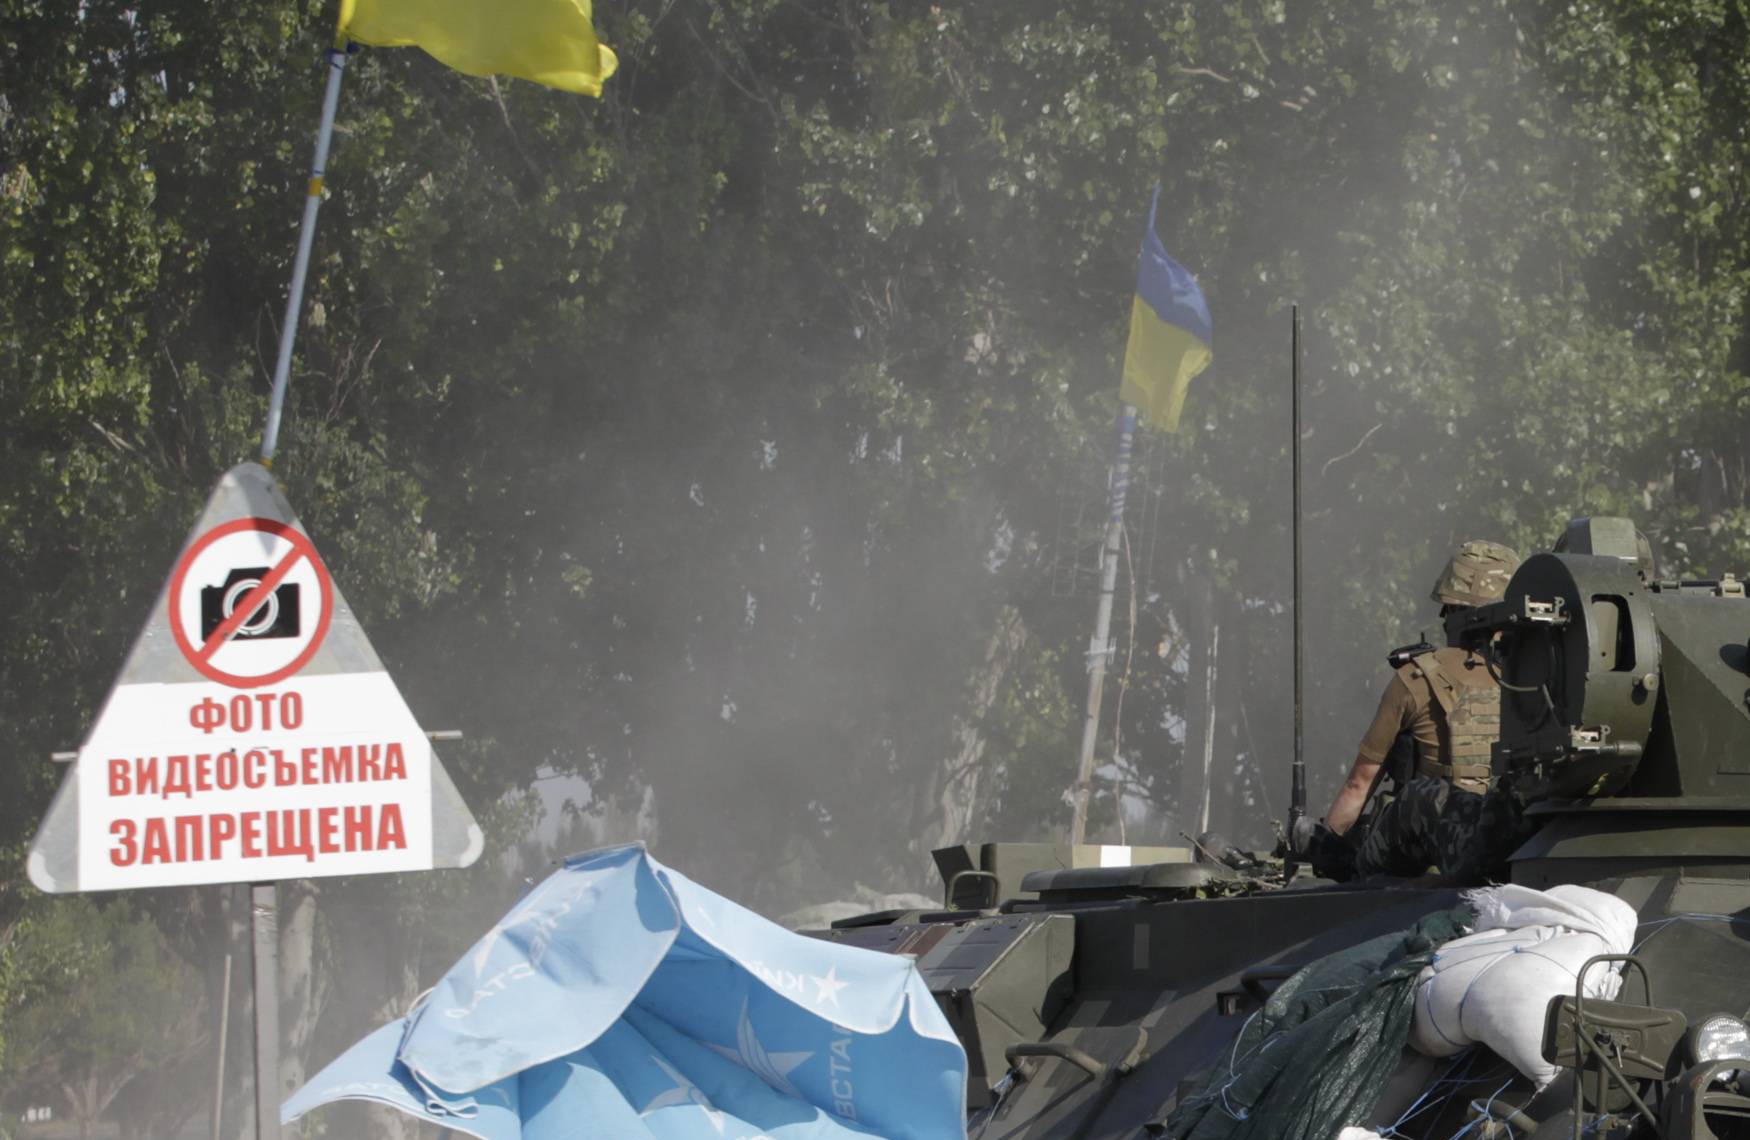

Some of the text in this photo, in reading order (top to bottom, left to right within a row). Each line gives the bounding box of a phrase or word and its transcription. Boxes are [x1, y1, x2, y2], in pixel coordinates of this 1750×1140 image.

[189, 691, 304, 734] ФОТО
[107, 742, 408, 800] ВИДЕОСЪЕМКА
[108, 803, 408, 868] ЗАПРЕЩЕНА
